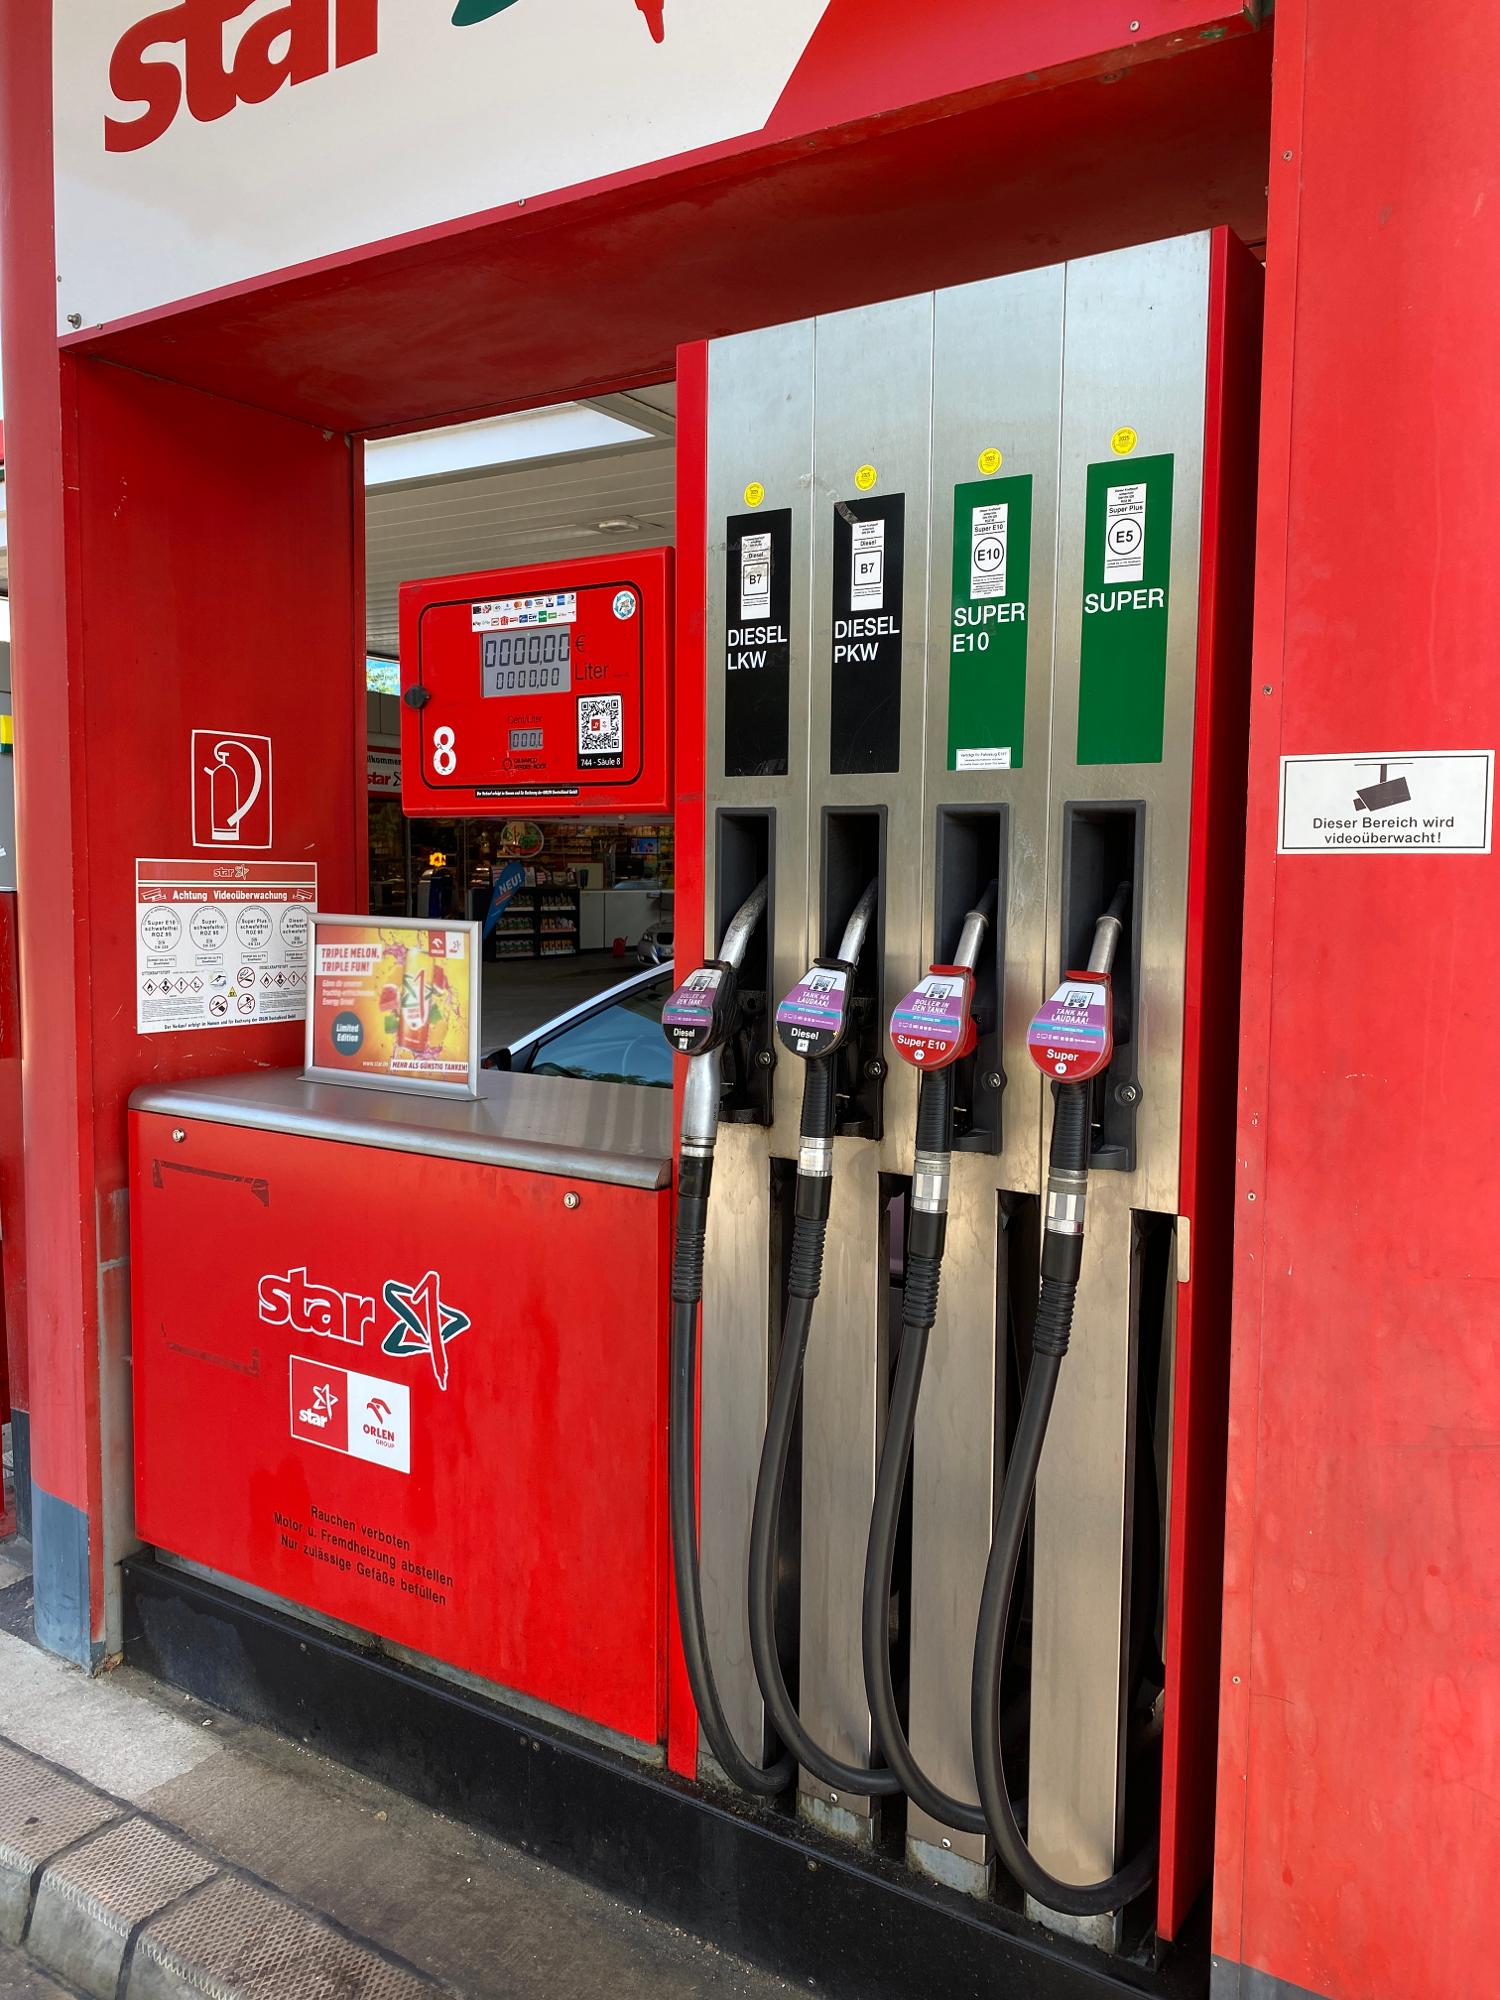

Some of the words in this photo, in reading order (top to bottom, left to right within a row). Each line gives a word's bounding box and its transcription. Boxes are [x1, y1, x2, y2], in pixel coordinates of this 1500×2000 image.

[860, 539, 876, 547] Diesel
[1116, 530, 1133, 543] E5
[977, 548, 1000, 562] E10
[860, 563, 875, 574] B7
[749, 574, 762, 585] B7
[1084, 588, 1165, 614] SUPER
[953, 602, 1026, 627] SUPER
[835, 616, 900, 639] DIESEL
[728, 625, 788, 647] DIESEL
[953, 631, 989, 653] E10
[834, 642, 880, 663] PKW
[728, 651, 767, 670] LKW
[575, 661, 608, 680] Liter
[433, 726, 456, 776] 8
[581, 758, 592, 767] 744
[616, 757, 621, 766] 8
[1313, 817, 1358, 829] Dieser
[1362, 816, 1418, 829] Bereich
[1422, 816, 1454, 828] wird
[1324, 832, 1441, 844] videoüberwacht!
[213, 867, 234, 877] star
[499, 873, 522, 895] NEU!
[173, 890, 207, 901] Achtung
[213, 890, 287, 901] Videoüberwachung
[321, 948, 348, 958] TRIPLE
[350, 948, 379, 959] MELON,
[322, 962, 349, 971] TRIPLE
[351, 962, 369, 971] FUN!
[915, 999, 941, 1007] BOLLER
[927, 1006, 947, 1014] TANK!
[336, 1024, 359, 1032] Limited
[674, 1027, 695, 1037] Diesel
[791, 1027, 819, 1040] Diesel
[337, 1033, 359, 1042] Edition
[897, 1035, 926, 1048] Super
[928, 1040, 946, 1051] E10
[1046, 1048, 1079, 1062] Super
[420, 1062, 443, 1070] GÜNSTIG
[258, 1267, 375, 1346] star
[299, 1408, 328, 1428] star
[363, 1424, 394, 1442] ORLEN
[375, 1439, 395, 1449] GROUP
[311, 1505, 356, 1532] Rauchen
[361, 1525, 411, 1551] verboten
[274, 1511, 303, 1532] Motor
[308, 1526, 317, 1539] u.
[321, 1529, 397, 1569] Fremdheizung
[401, 1559, 453, 1588] abstellen
[281, 1534, 299, 1551] Nur
[303, 1543, 351, 1571] zulässige
[356, 1562, 396, 1587] Gefäße
[400, 1578, 447, 1606] befüllen
